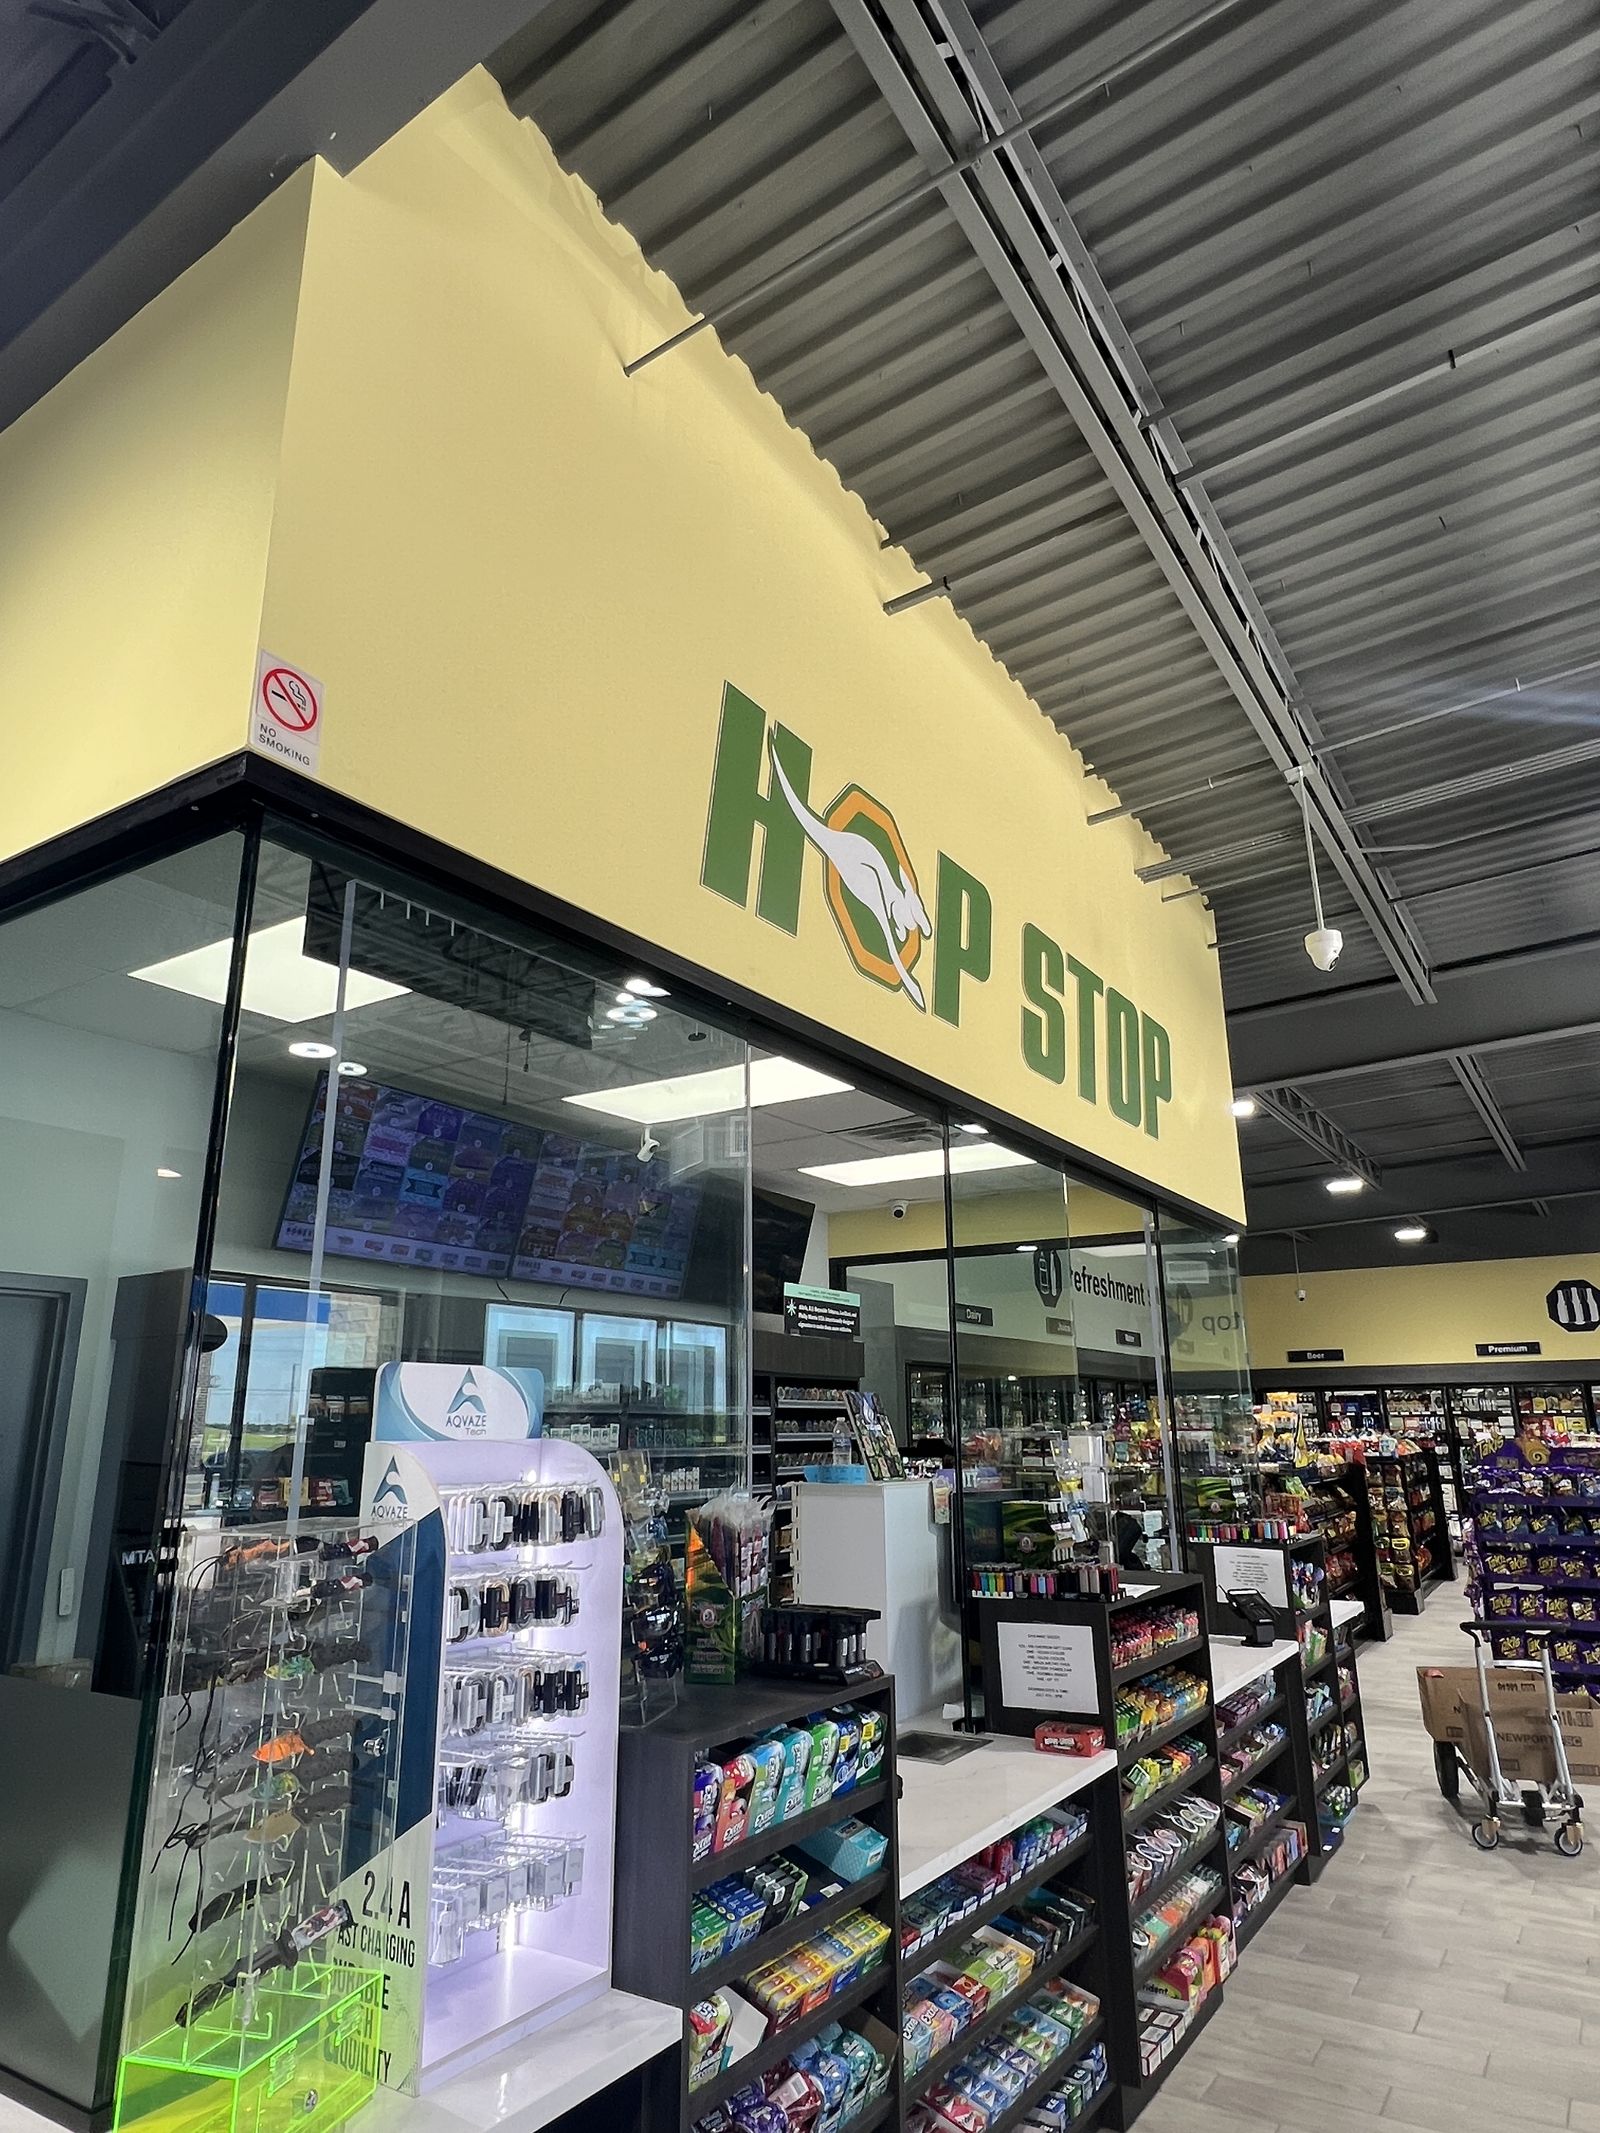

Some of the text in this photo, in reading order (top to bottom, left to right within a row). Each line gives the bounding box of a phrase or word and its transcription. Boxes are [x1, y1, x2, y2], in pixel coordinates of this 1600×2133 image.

[260, 723, 277, 738] NO
[259, 733, 310, 766] SMOKING
[700, 680, 1172, 1140] HOP STOP
[966, 1308, 982, 1323] Dairy
[1488, 1344, 1528, 1354] Premium
[445, 1415, 487, 1427] AQVAZE
[465, 1428, 487, 1436] Tech
[370, 1505, 408, 1519] AQVAZE
[338, 1922, 358, 1949] AST
[1143, 1984, 1169, 1996] rident
